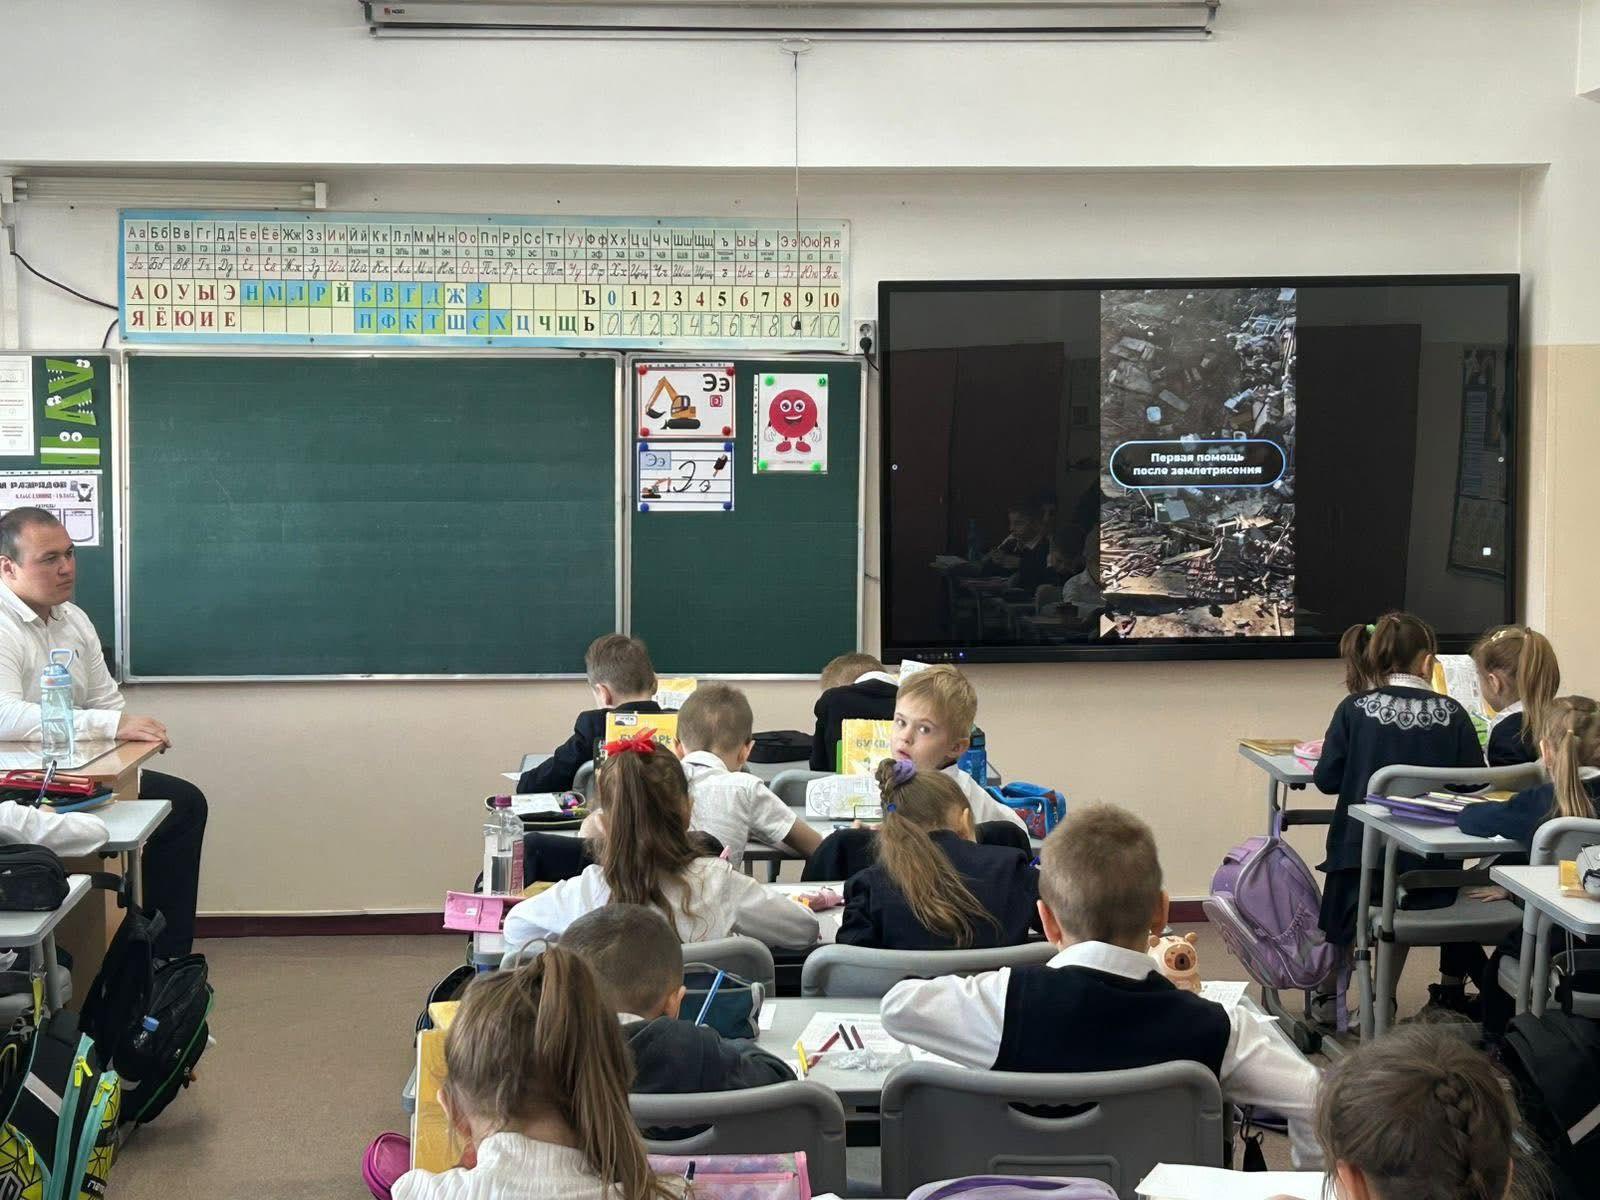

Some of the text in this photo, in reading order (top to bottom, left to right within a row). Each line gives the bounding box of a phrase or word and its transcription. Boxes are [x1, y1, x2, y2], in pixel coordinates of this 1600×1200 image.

[131, 283, 840, 307] А О У Ы Э Н М Л Р Й Б В Г Д Ж З Ъ 0 1 2 3 4 5 6 7 8 9 10
[132, 311, 144, 326] Я
[156, 307, 167, 326] Ё
[175, 311, 194, 326] Ю
[200, 312, 213, 326] И
[225, 312, 236, 327] Е
[361, 314, 371, 329] П
[381, 314, 396, 329] Ф
[406, 314, 416, 329] К
[428, 314, 440, 329] Т
[448, 315, 465, 329] Ш
[473, 315, 484, 330] С
[495, 315, 506, 330] Х
[517, 315, 530, 334] Ц
[540, 316, 550, 331] Ч
[559, 316, 577, 334] Щ
[584, 316, 594, 331] Ь
[702, 373, 730, 392] Ээ
[645, 453, 666, 467] Ээ
[1150, 453, 1244, 464] Первая помощь
[1133, 466, 1262, 477] после землетрясения
